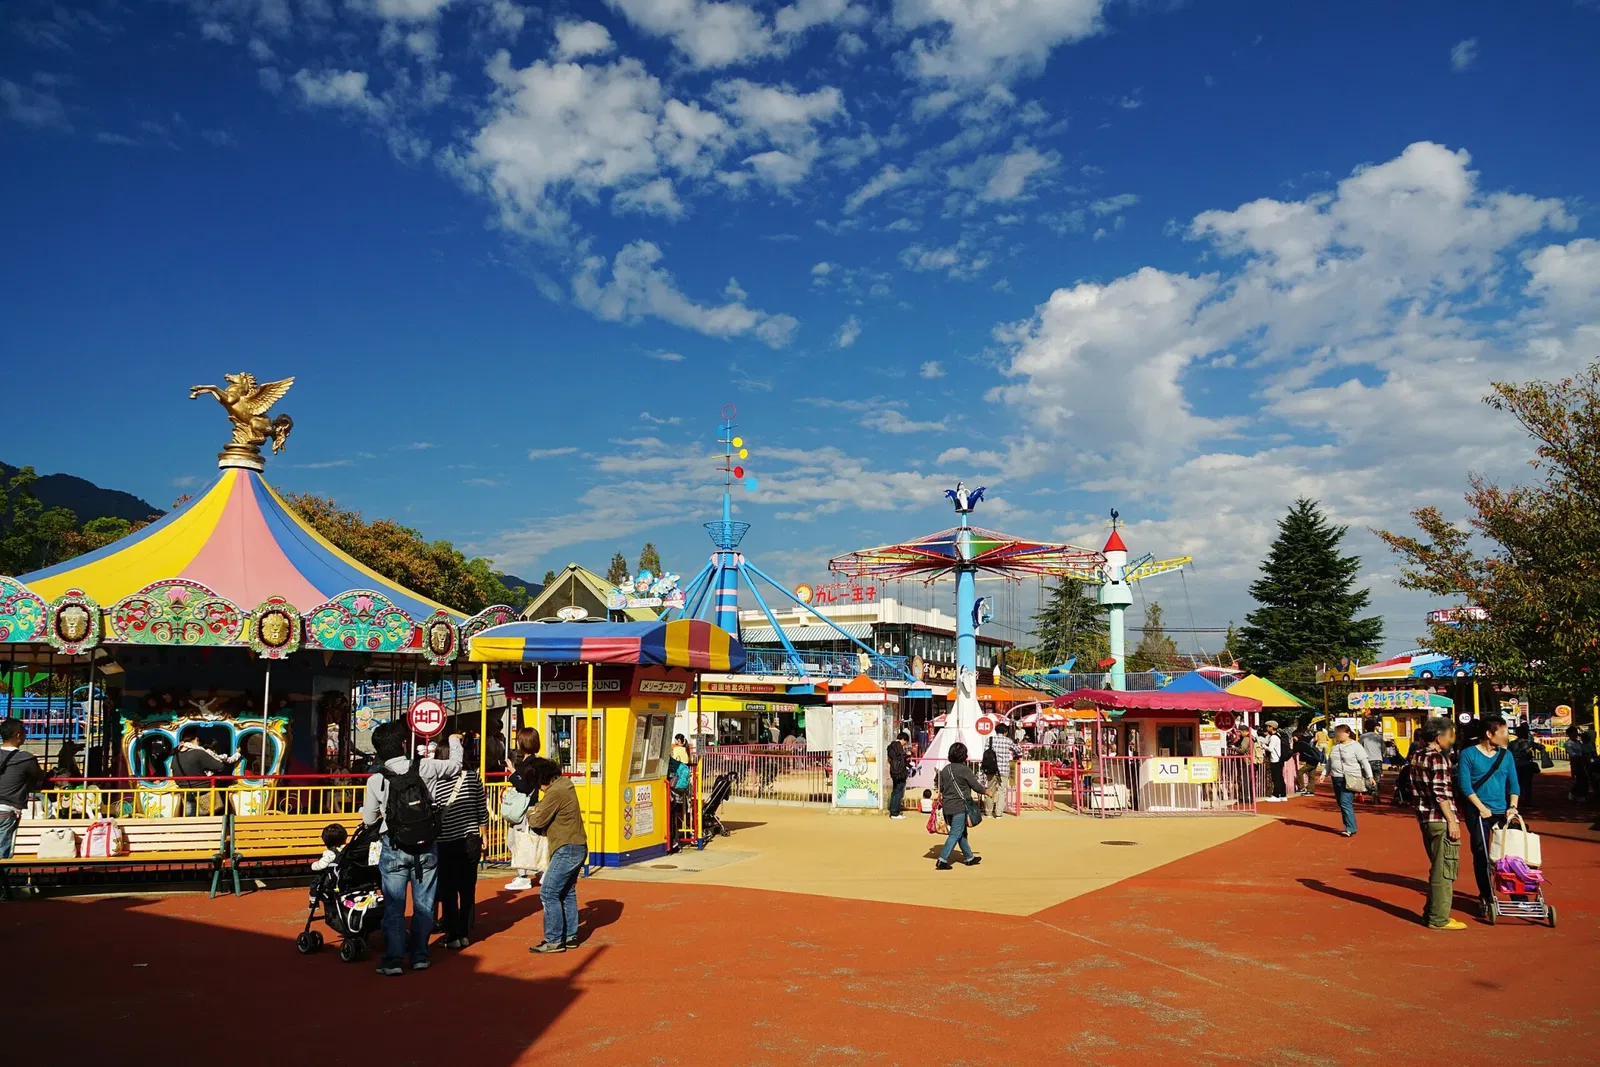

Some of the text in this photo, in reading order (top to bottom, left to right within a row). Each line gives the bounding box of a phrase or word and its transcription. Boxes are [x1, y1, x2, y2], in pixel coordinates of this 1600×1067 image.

[815, 586, 877, 603] カレー王子
[642, 682, 684, 692] メリーゴーランド
[711, 683, 751, 692] 遊園地案内所
[415, 709, 440, 723] 出口
[977, 722, 991, 731] 出口
[1218, 717, 1232, 726] 入口
[1159, 763, 1179, 775] 入口
